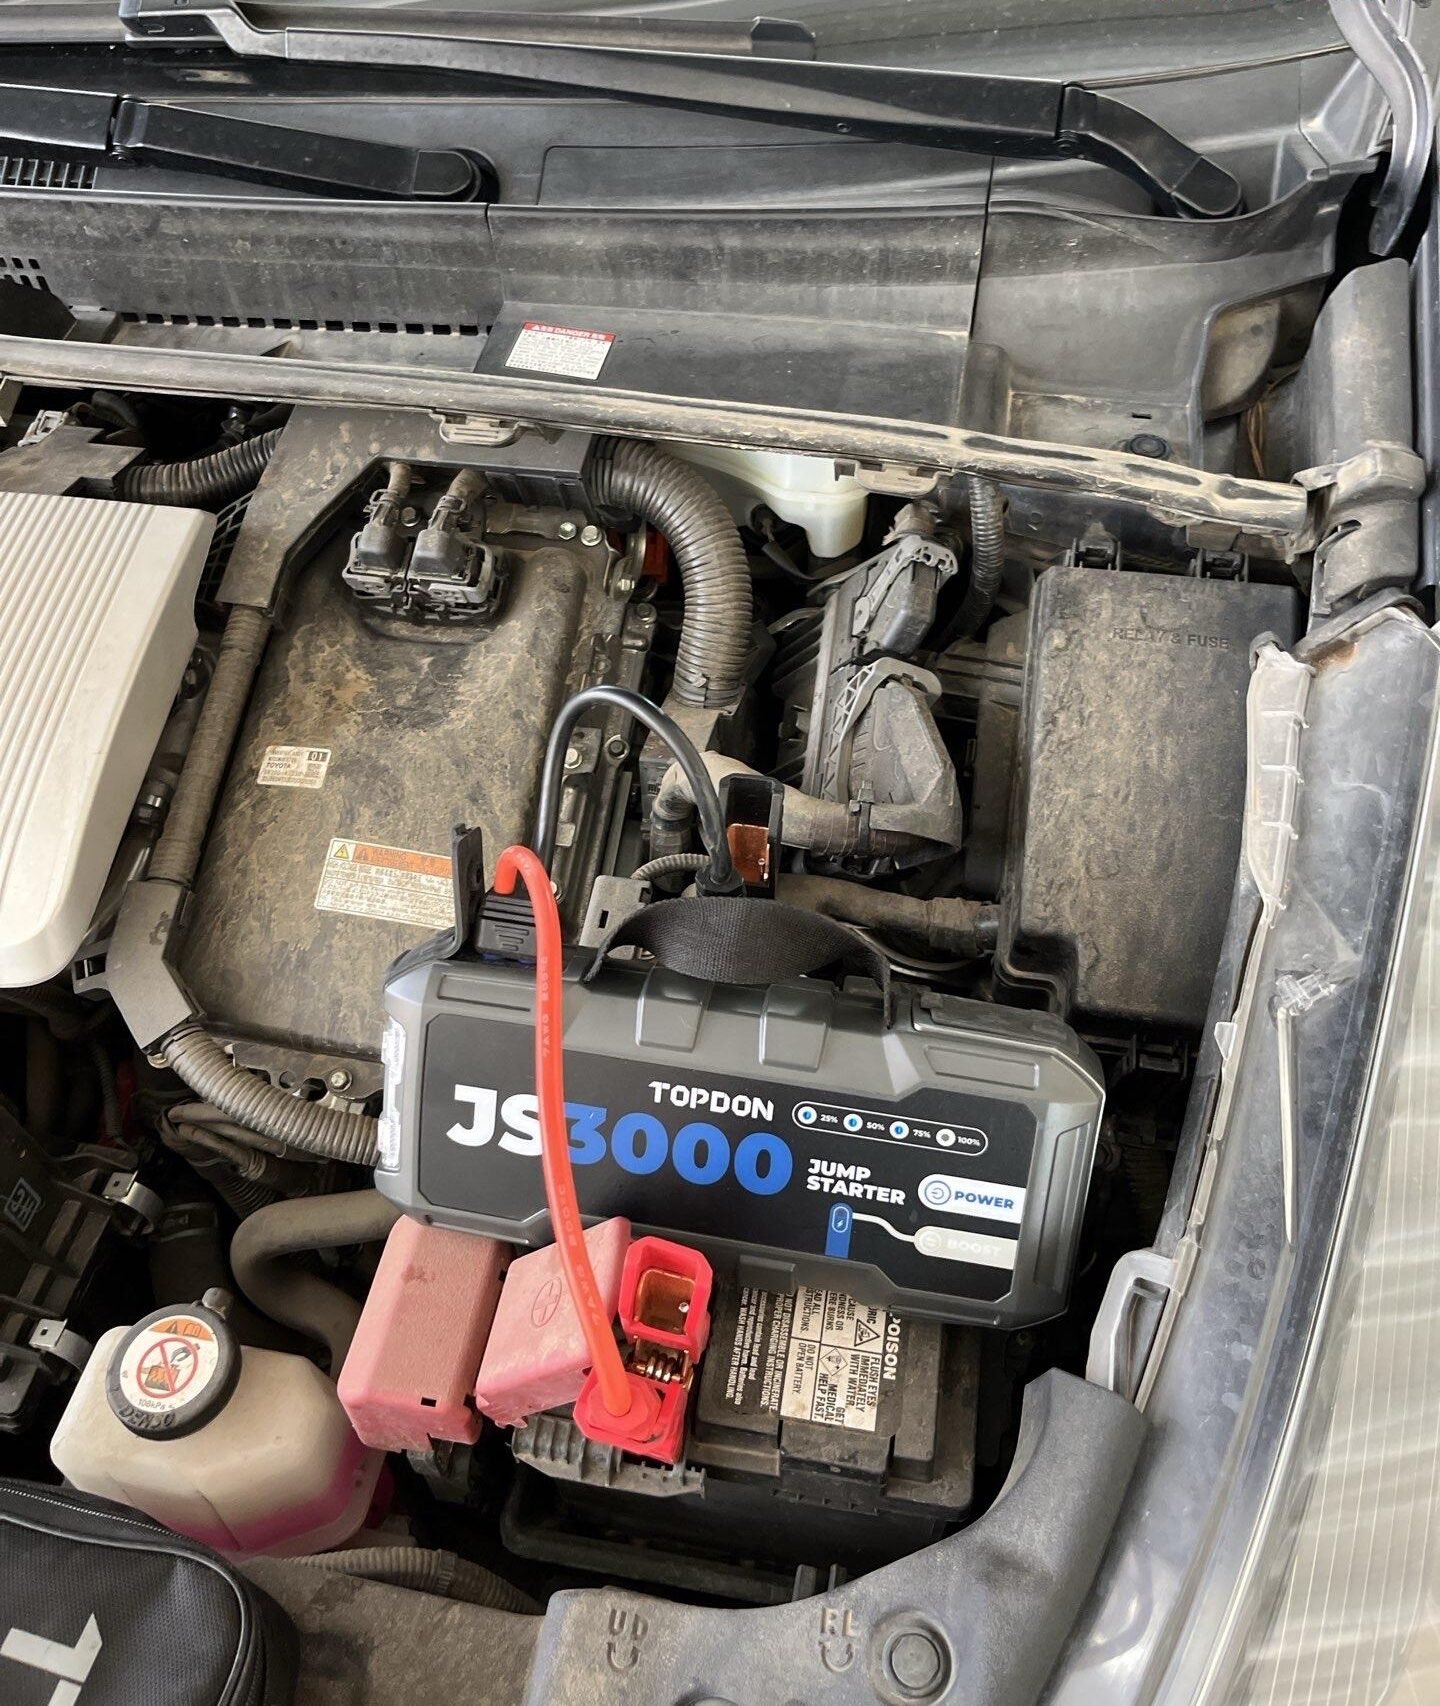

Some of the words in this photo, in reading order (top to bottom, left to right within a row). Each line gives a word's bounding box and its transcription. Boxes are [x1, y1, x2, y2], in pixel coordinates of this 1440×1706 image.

[1170, 632, 1180, 645] &
[1187, 634, 1231, 649] FUSE
[649, 1081, 775, 1122] TOPDON
[820, 1114, 838, 1124] 25%
[866, 1121, 885, 1132] 50%
[912, 1128, 931, 1139] 75%
[957, 1135, 981, 1147] 100%
[808, 1158, 871, 1182] JUMP
[806, 1175, 906, 1206] STARTER
[954, 1190, 1014, 1210] POWER
[738, 1307, 747, 1324] WASH
[784, 1299, 793, 1312] NOT
[812, 1303, 821, 1315] ALL
[847, 1298, 858, 1320] CAUSE
[825, 1306, 837, 1332] BURNS.
[835, 1320, 844, 1331] OR
[734, 1325, 744, 1346] HANDS
[768, 1320, 781, 1354] CHARGING
[777, 1313, 790, 1358] DISASSEMBLE
[731, 1347, 741, 1366] AFTER
[797, 1342, 807, 1361] OPEN
[807, 1344, 816, 1354] DO
[750, 1356, 758, 1367] and
[775, 1359, 785, 1369] OR
[805, 1355, 814, 1370] NOT
[849, 1354, 860, 1375] WITH
[869, 1357, 880, 1383] FLUSH
[736, 1367, 748, 1392] Batteries
[748, 1367, 757, 1380] lead
[760, 1356, 775, 1408] INSTRUCTIONS.
[793, 1363, 804, 1395] BATTERY.
[818, 1373, 829, 1394] HELP
[856, 1355, 872, 1412] IMMEDIATELY
[825, 1384, 838, 1421] MEDICAL
[845, 1377, 857, 1409] WATER.
[867, 1385, 877, 1407] EYES
[814, 1396, 826, 1419] FAST.
[835, 1407, 846, 1424] GET
